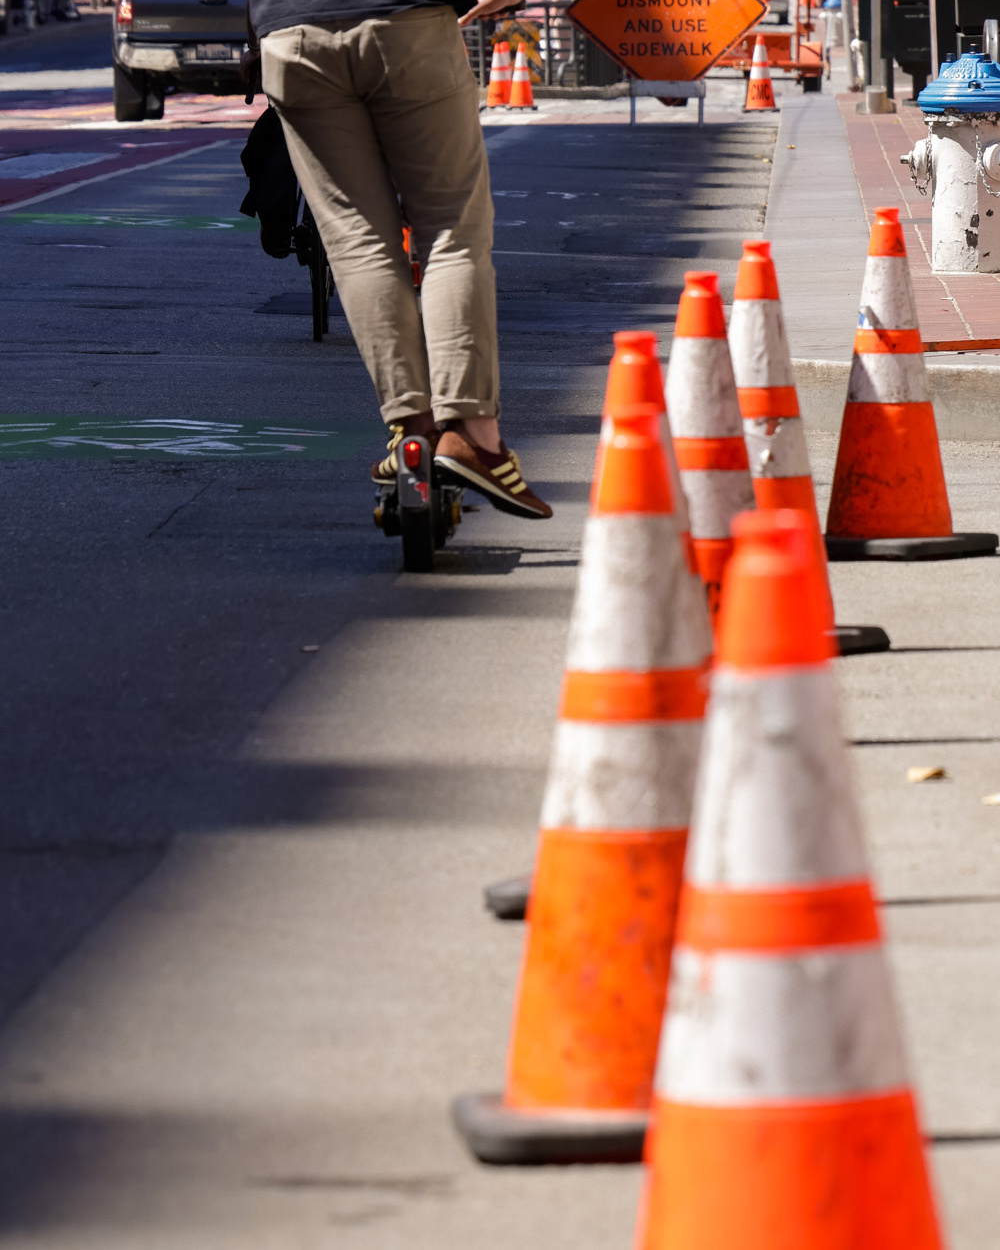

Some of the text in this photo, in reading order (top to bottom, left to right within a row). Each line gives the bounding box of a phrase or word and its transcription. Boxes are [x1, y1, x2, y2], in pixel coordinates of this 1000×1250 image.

[624, 19, 707, 33] AND USE
[618, 42, 712, 56] SIDEWALK
[751, 83, 771, 100] CMC
